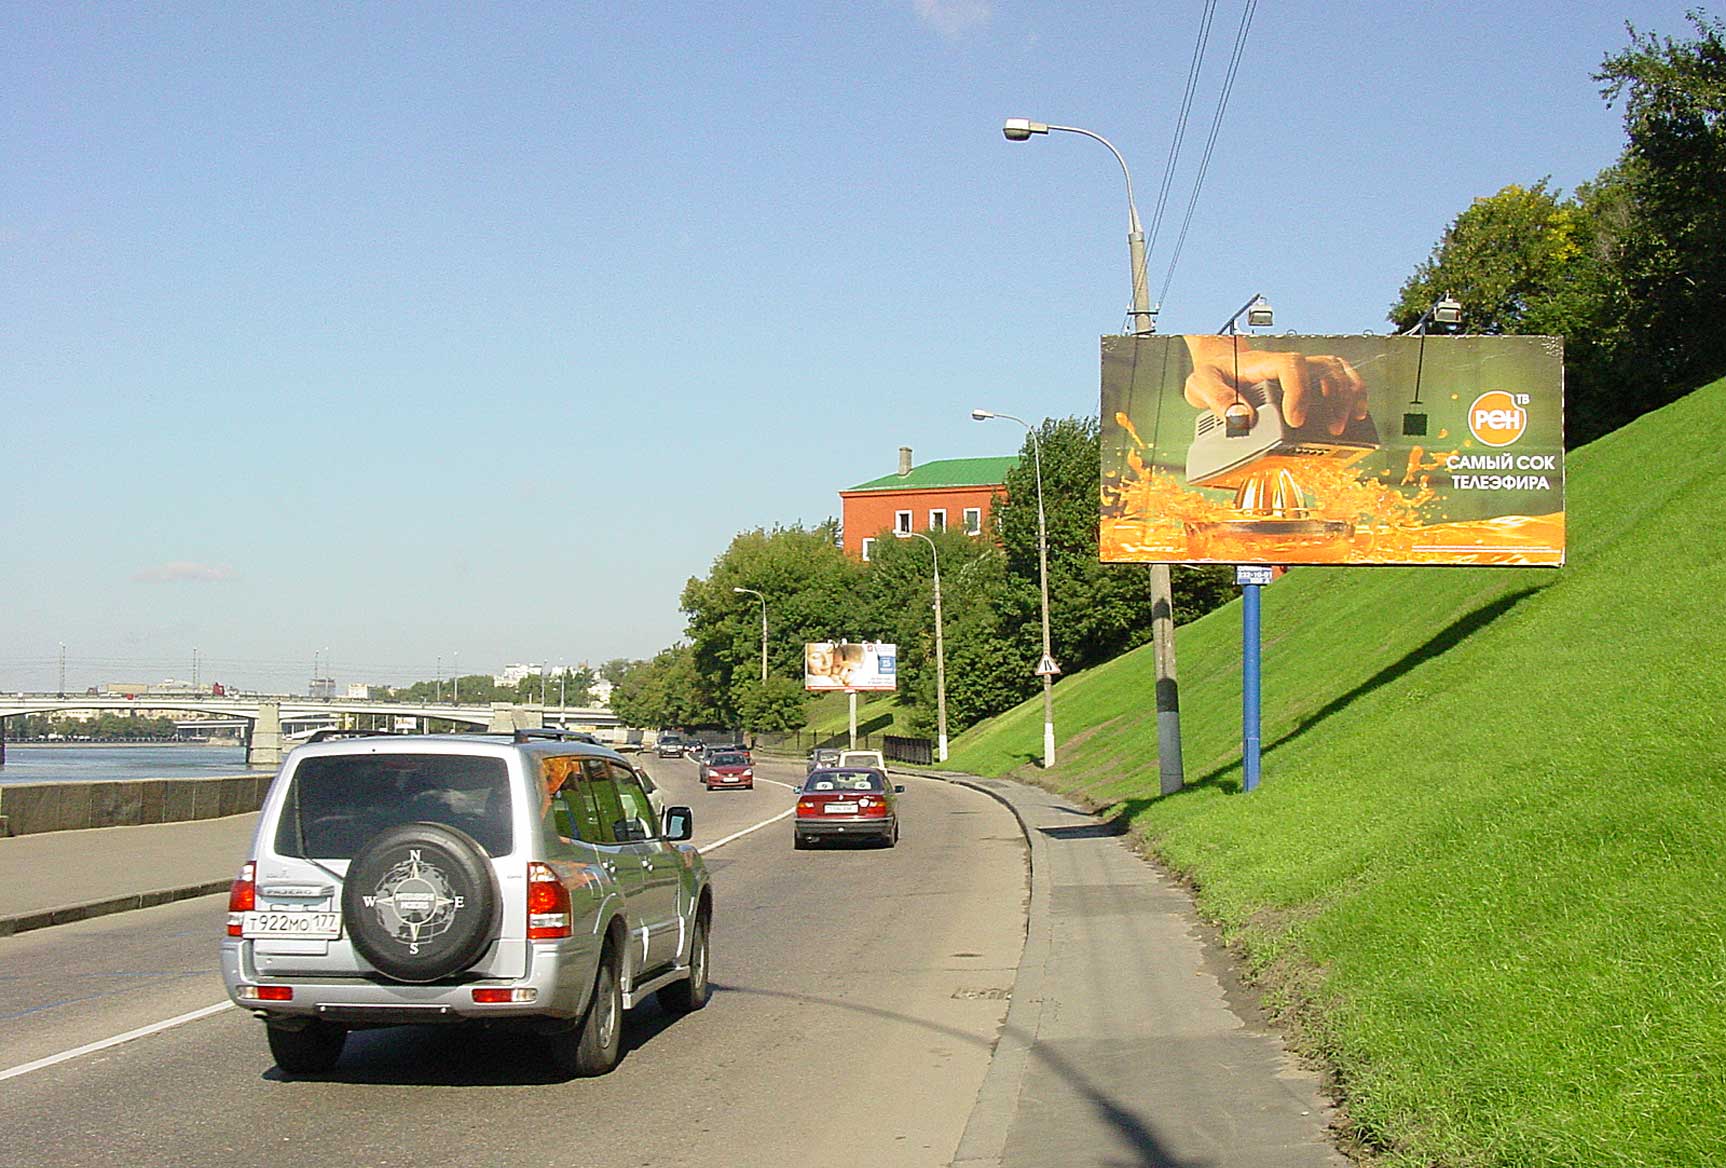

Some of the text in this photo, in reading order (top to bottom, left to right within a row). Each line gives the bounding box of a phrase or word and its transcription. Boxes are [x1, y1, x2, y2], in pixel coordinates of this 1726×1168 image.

[1516, 394, 1531, 405] ТВ
[1446, 452, 1556, 470] САМЫЙ СОК
[1451, 475, 1551, 490] ТЕЛЕЭФИРА
[410, 850, 422, 861] N
[362, 896, 378, 908] W
[454, 896, 465, 908] E
[249, 914, 337, 931] Т922МО 177
[409, 942, 420, 955] S
